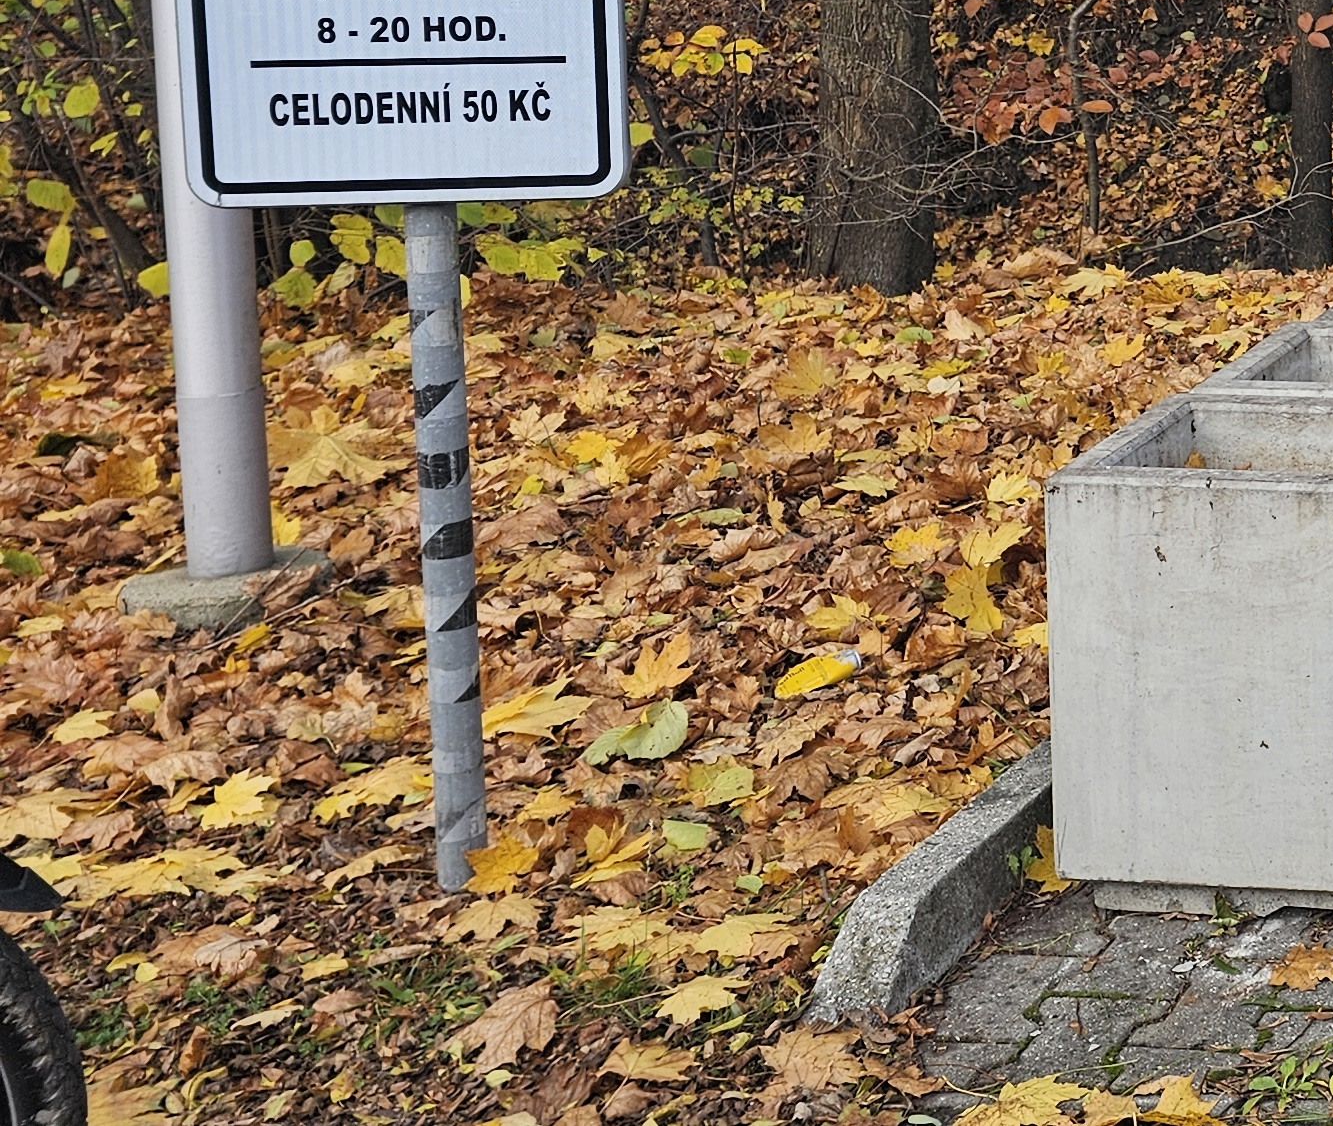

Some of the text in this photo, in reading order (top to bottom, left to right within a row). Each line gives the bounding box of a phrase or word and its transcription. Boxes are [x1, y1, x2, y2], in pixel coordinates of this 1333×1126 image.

[317, 17, 337, 44] 8
[369, 16, 411, 43] 20
[422, 15, 507, 43] HOD.
[269, 80, 552, 127] CELODENNÍ 50 KČ
